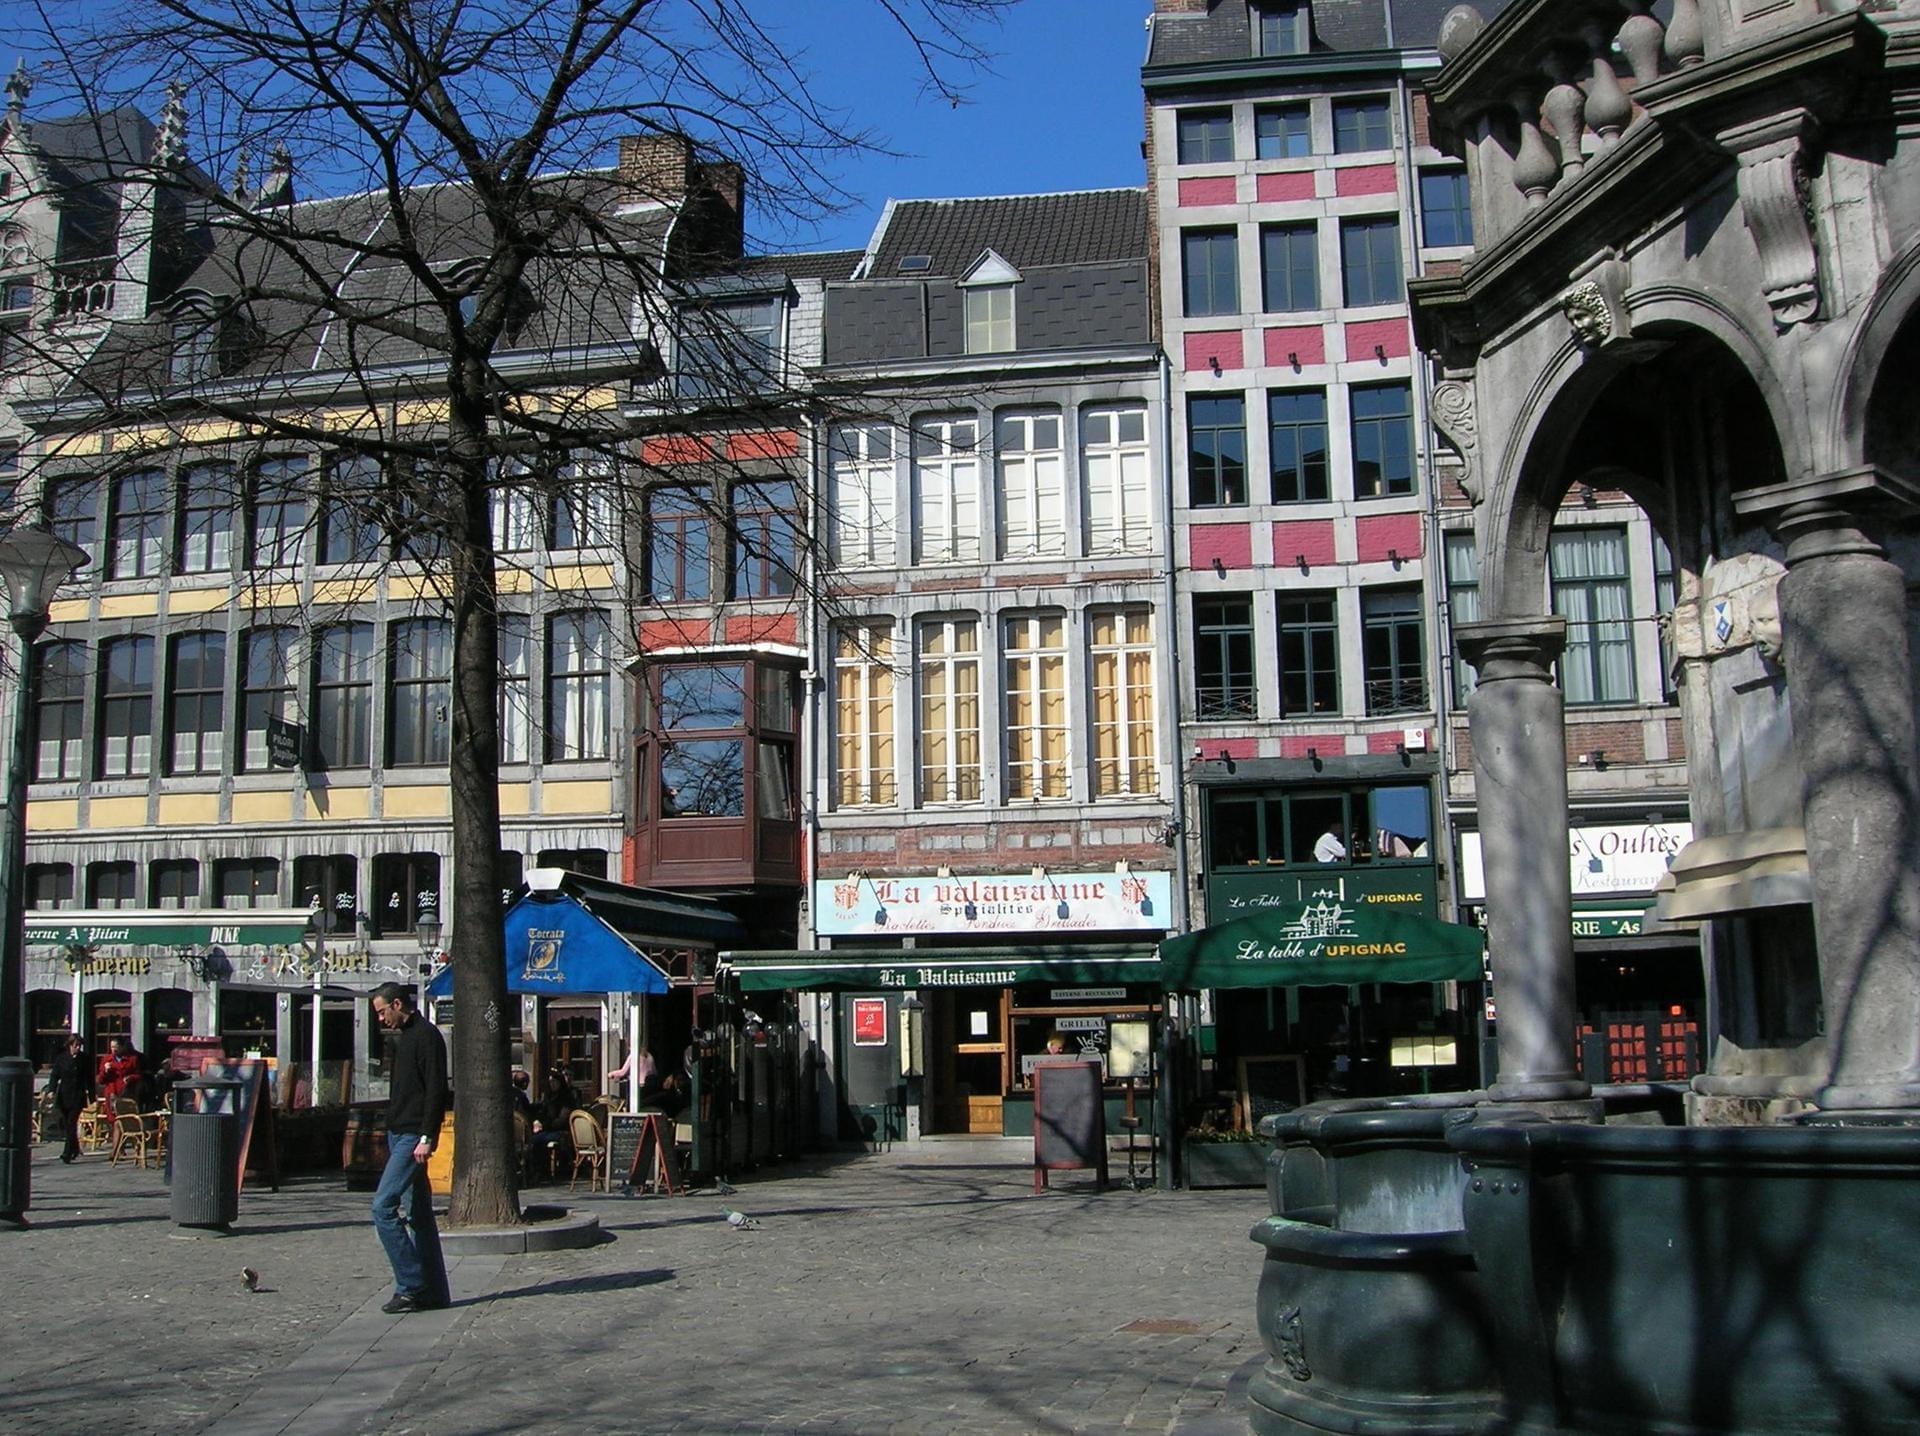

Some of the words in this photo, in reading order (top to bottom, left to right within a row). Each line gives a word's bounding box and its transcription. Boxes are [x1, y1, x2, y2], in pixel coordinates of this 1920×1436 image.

[1600, 825, 1680, 855] Ouhès
[1577, 864, 1661, 888] Restauran
[876, 880, 920, 903] La
[1229, 896, 1246, 908] La
[1249, 894, 1282, 907] Table
[210, 926, 241, 943] DUKE
[1235, 940, 1265, 960] La
[1268, 941, 1305, 959] table
[880, 969, 906, 986] La
[917, 968, 1017, 985] Valaisanne
